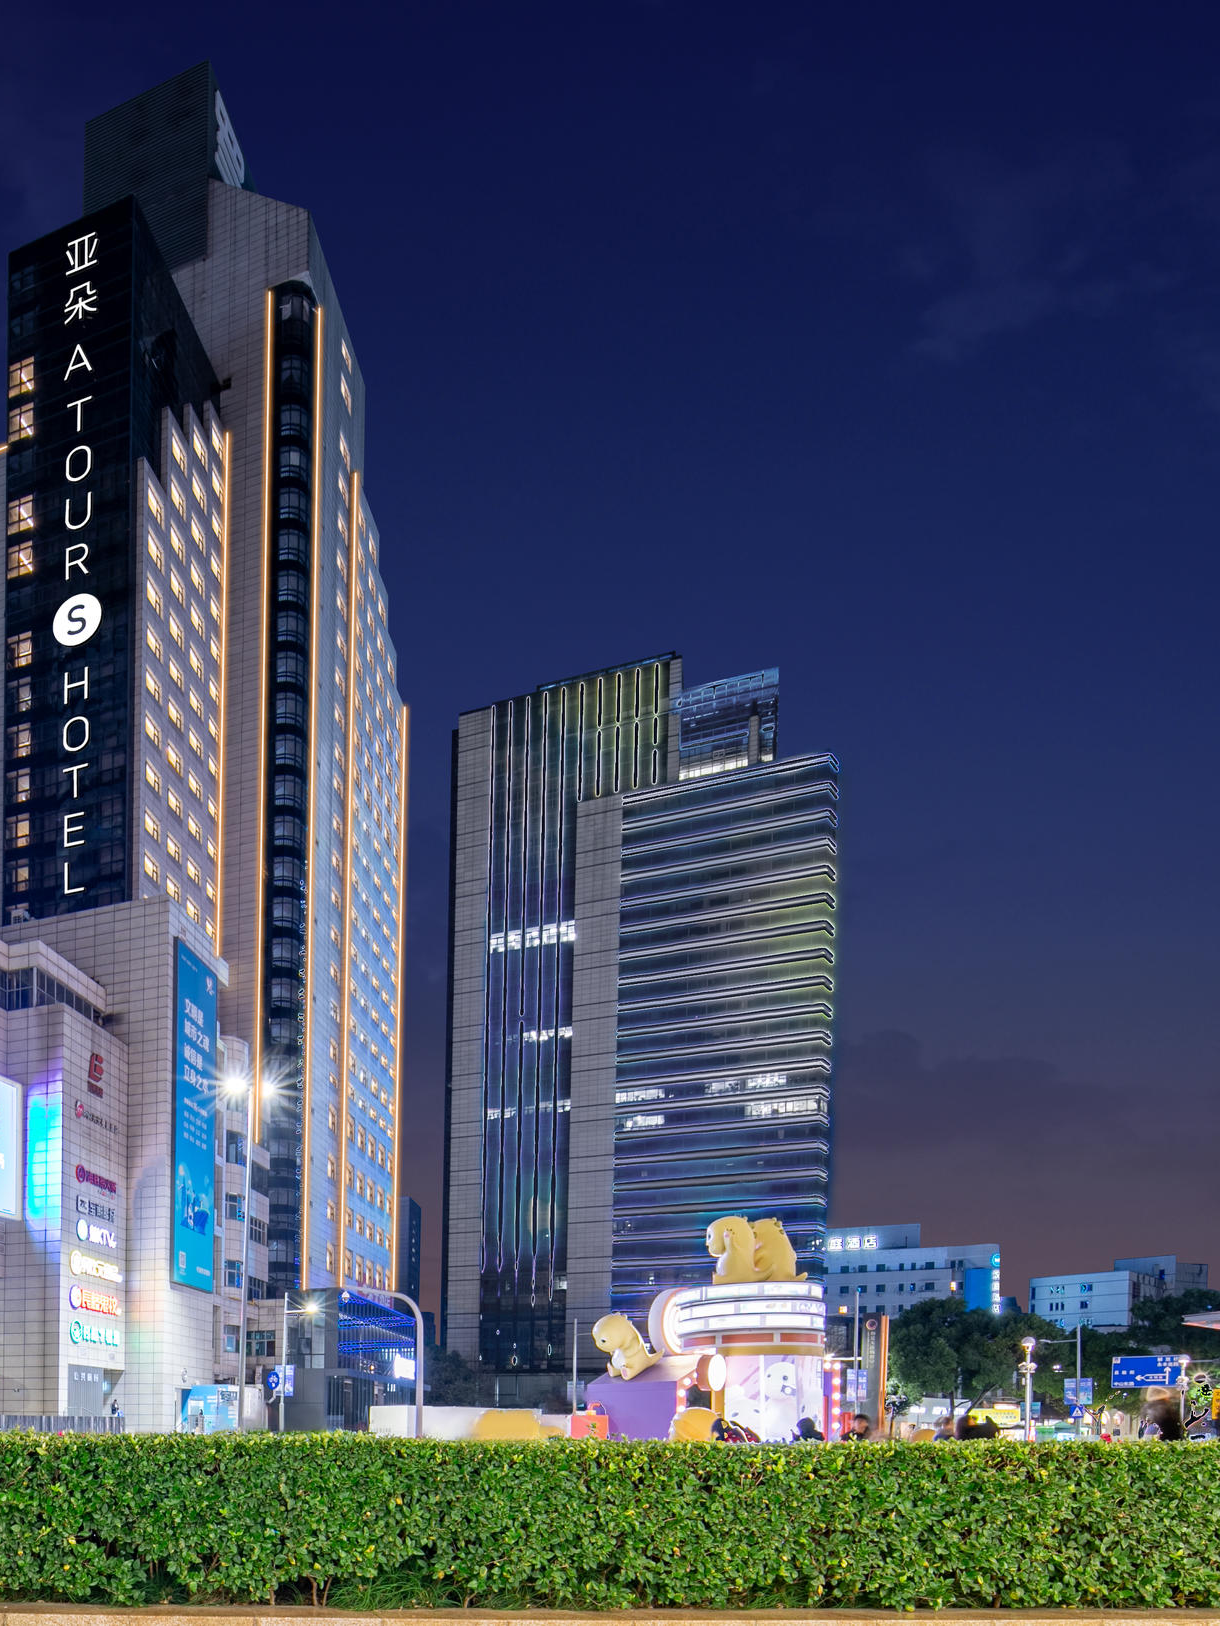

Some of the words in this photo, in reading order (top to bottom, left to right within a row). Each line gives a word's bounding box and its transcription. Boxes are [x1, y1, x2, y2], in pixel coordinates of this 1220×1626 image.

[64, 231, 99, 325] 亚朵
[63, 343, 93, 581] ATOUR
[66, 604, 87, 636] S
[62, 666, 91, 895] HOTEL
